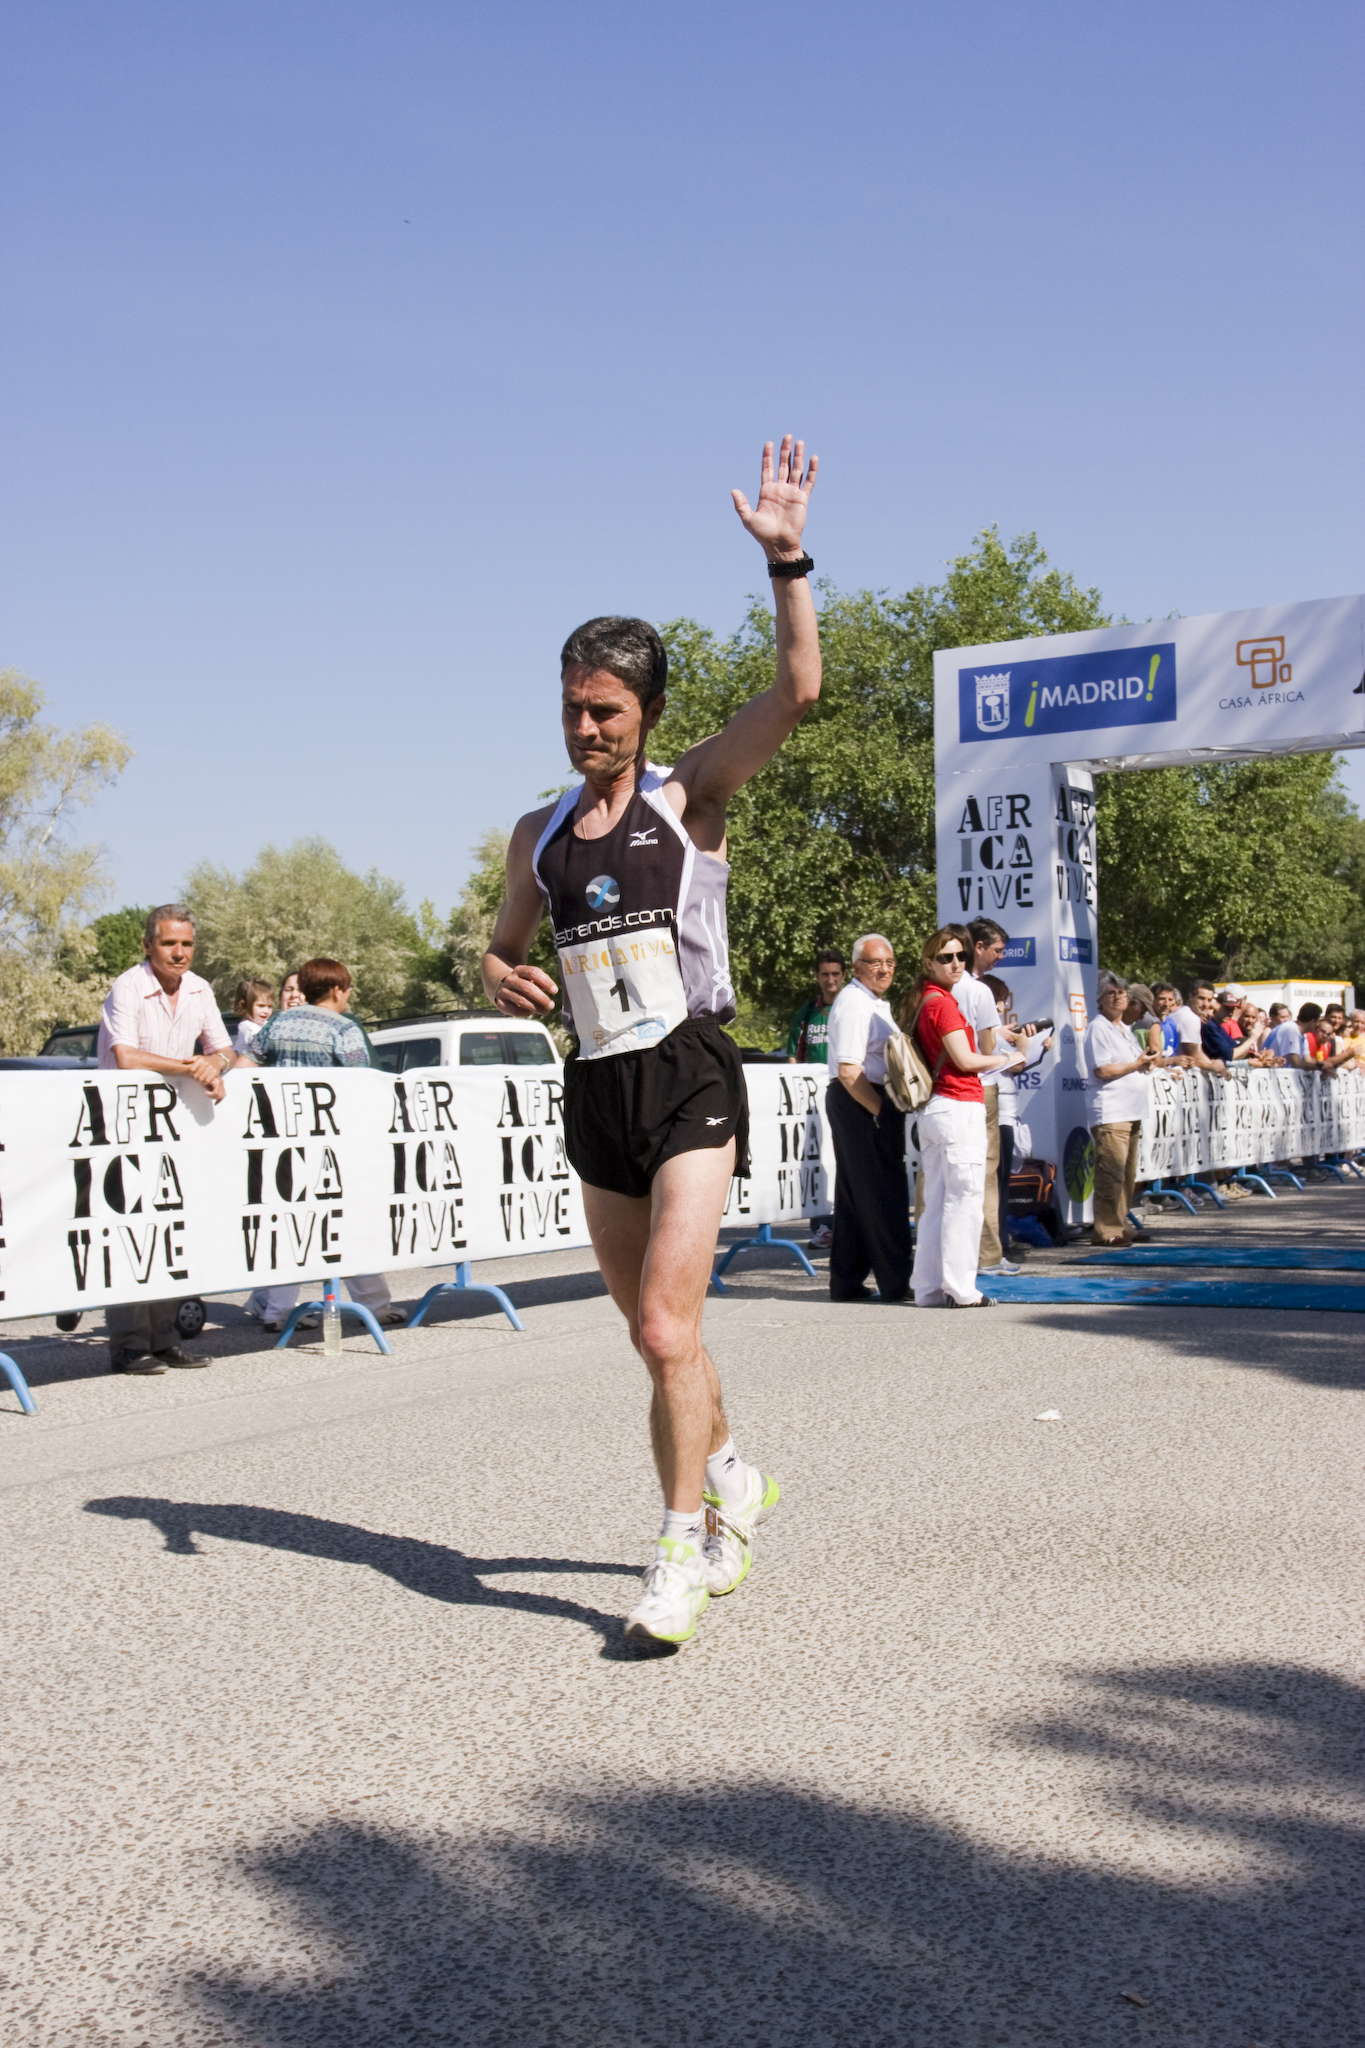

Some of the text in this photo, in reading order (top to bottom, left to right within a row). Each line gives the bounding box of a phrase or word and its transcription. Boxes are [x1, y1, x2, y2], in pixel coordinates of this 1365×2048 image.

[1024, 653, 1161, 728] ¡MADRID!
[1219, 691, 1305, 710] CASA ÁFRICA
[958, 833, 1033, 872] ICA
[609, 978, 631, 1013] 1
[388, 1140, 463, 1195] ICA
[499, 1133, 570, 1185] ICA
[777, 1121, 820, 1164] ICA
[68, 1152, 184, 1219] ICA
[242, 1145, 343, 1206] ICA
